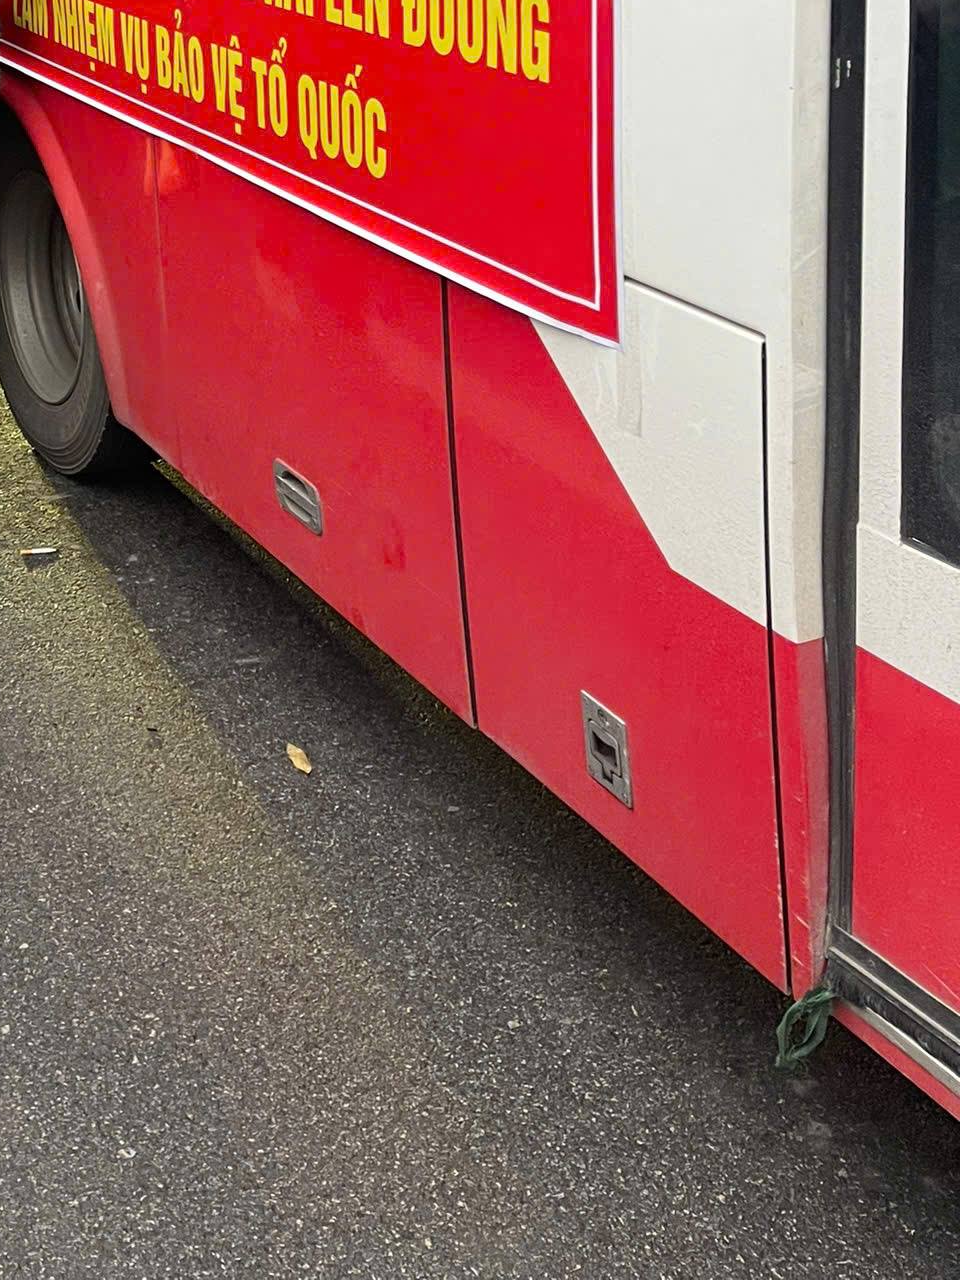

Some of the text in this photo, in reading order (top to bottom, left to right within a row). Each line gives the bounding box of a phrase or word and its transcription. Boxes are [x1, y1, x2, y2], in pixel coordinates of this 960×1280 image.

[120, 11, 149, 94] VỤ
[155, 8, 205, 104] BẢO
[210, 35, 246, 136] VỆ
[250, 36, 289, 138] TỔ
[297, 64, 388, 180] QUỐC
